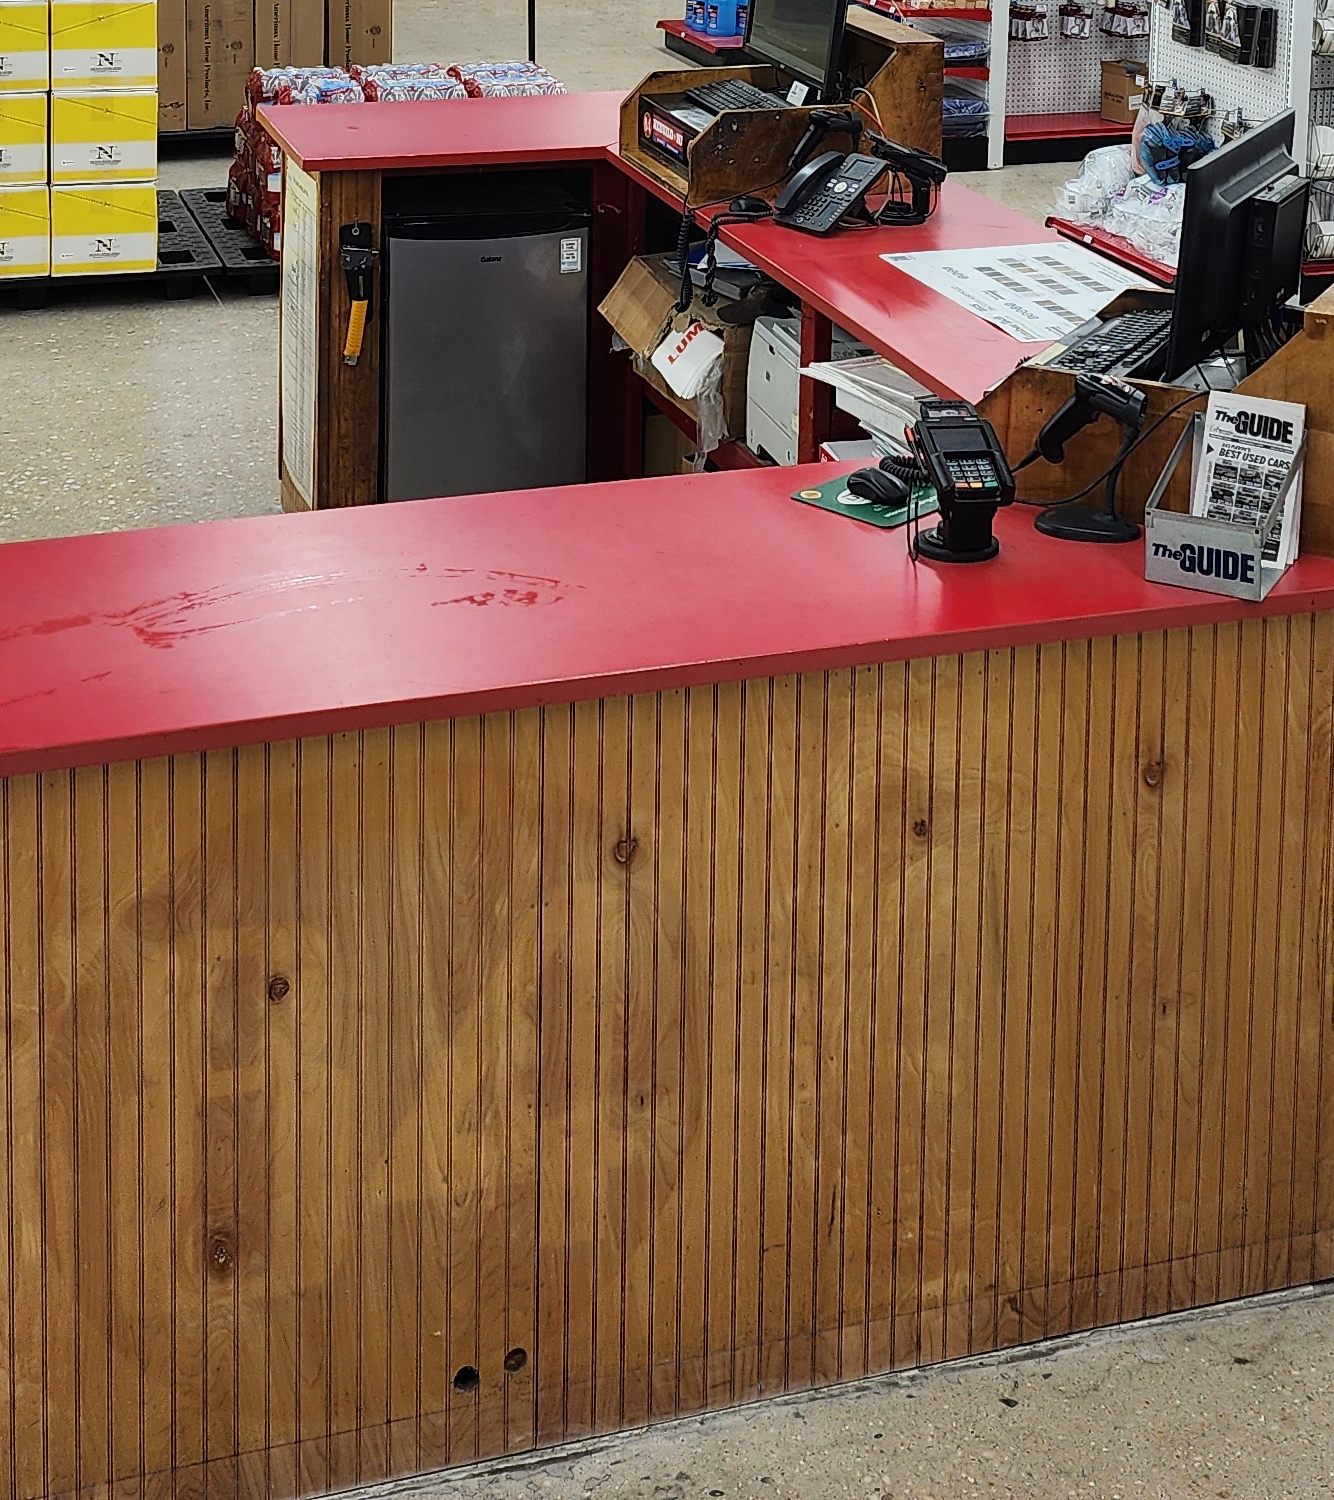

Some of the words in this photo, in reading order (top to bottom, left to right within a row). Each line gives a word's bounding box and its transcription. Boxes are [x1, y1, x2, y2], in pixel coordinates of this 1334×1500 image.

[1214, 409, 1238, 425] The
[1235, 410, 1294, 445] GUIDE
[1219, 447, 1242, 461] BEST
[1242, 452, 1266, 466] USED
[1267, 457, 1292, 471] CARS
[1151, 542, 1183, 560] The
[1179, 543, 1255, 585] GUIDE
